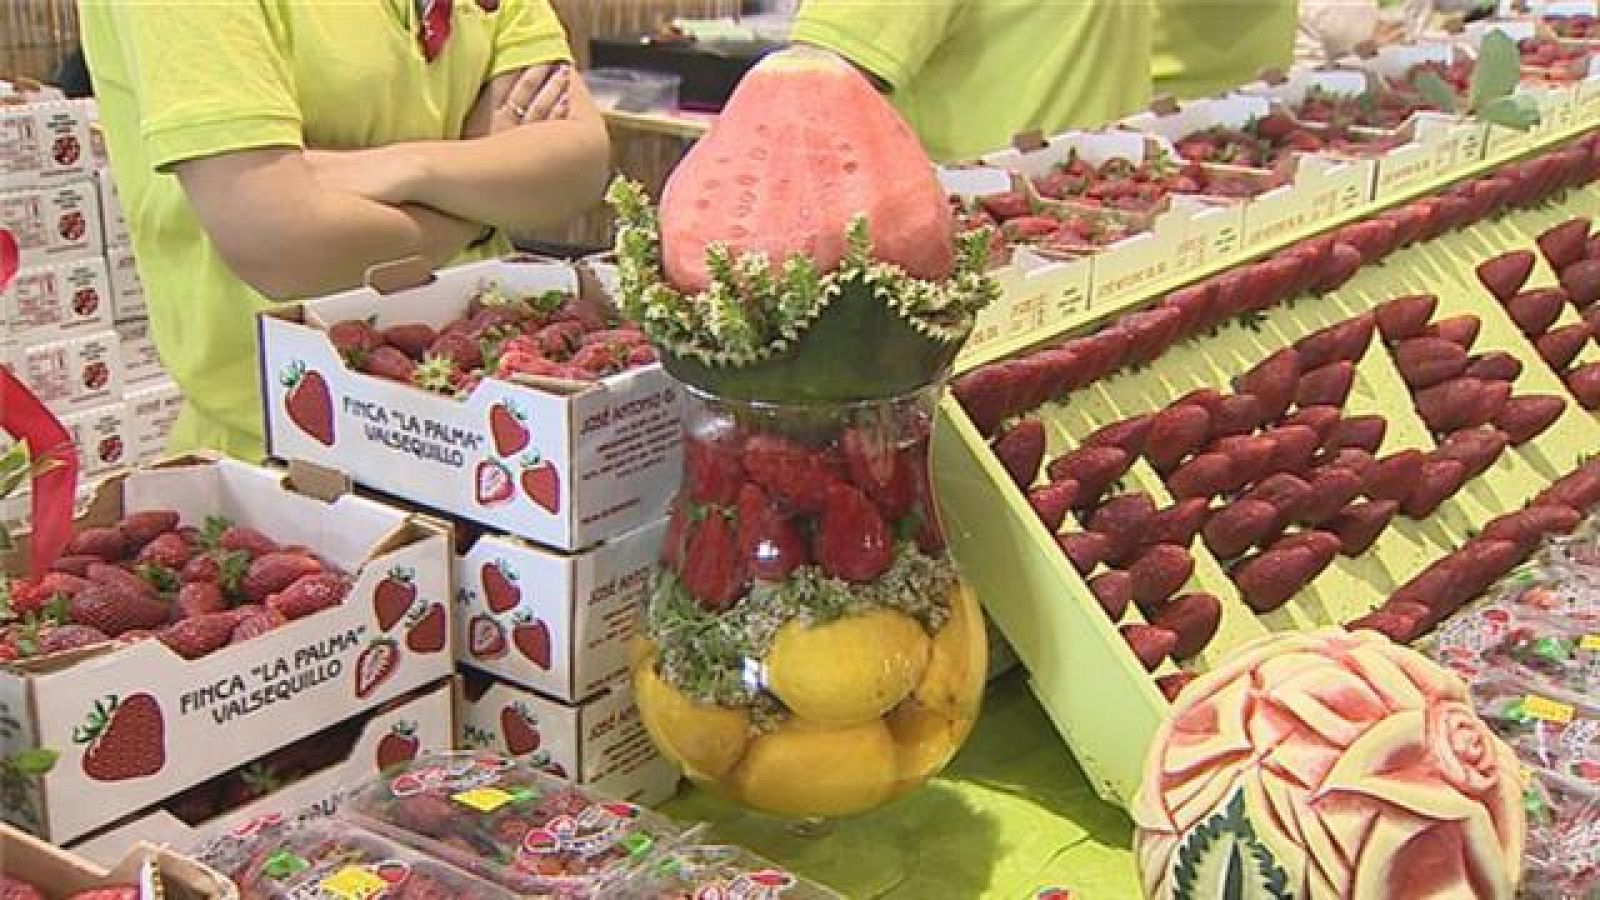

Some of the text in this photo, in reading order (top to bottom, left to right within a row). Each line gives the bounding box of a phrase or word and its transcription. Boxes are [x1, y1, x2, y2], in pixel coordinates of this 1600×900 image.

[343, 397, 388, 424] FINCA
[364, 423, 463, 467] VALSEQUILLO
[180, 674, 245, 715] FINCA
[212, 659, 342, 724] VALSEQUILLO
